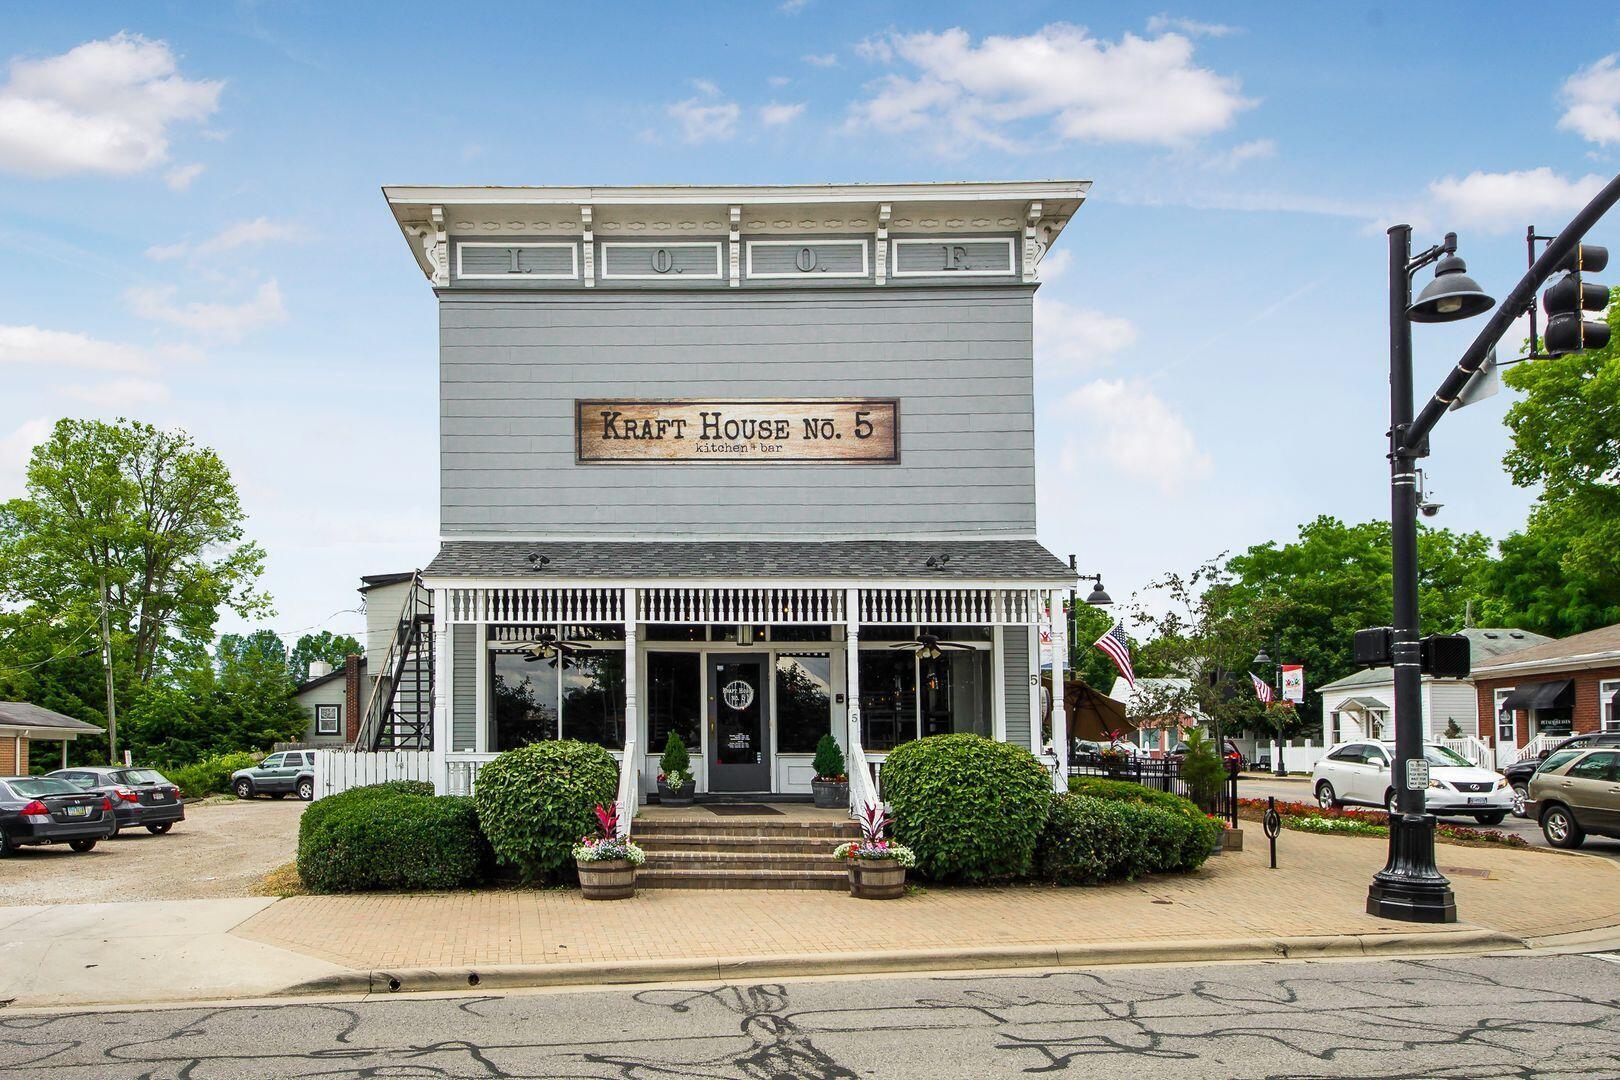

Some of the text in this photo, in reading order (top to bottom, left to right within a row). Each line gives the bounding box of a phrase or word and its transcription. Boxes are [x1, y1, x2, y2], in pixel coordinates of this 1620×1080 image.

[942, 246, 971, 271] F.
[600, 411, 687, 441] KRAFT
[699, 411, 790, 441] HOUSE
[854, 411, 874, 440] 5
[695, 442, 749, 454] kitchen
[760, 442, 783, 454] bar
[1030, 674, 1038, 686] 5
[851, 713, 858, 723] 5
